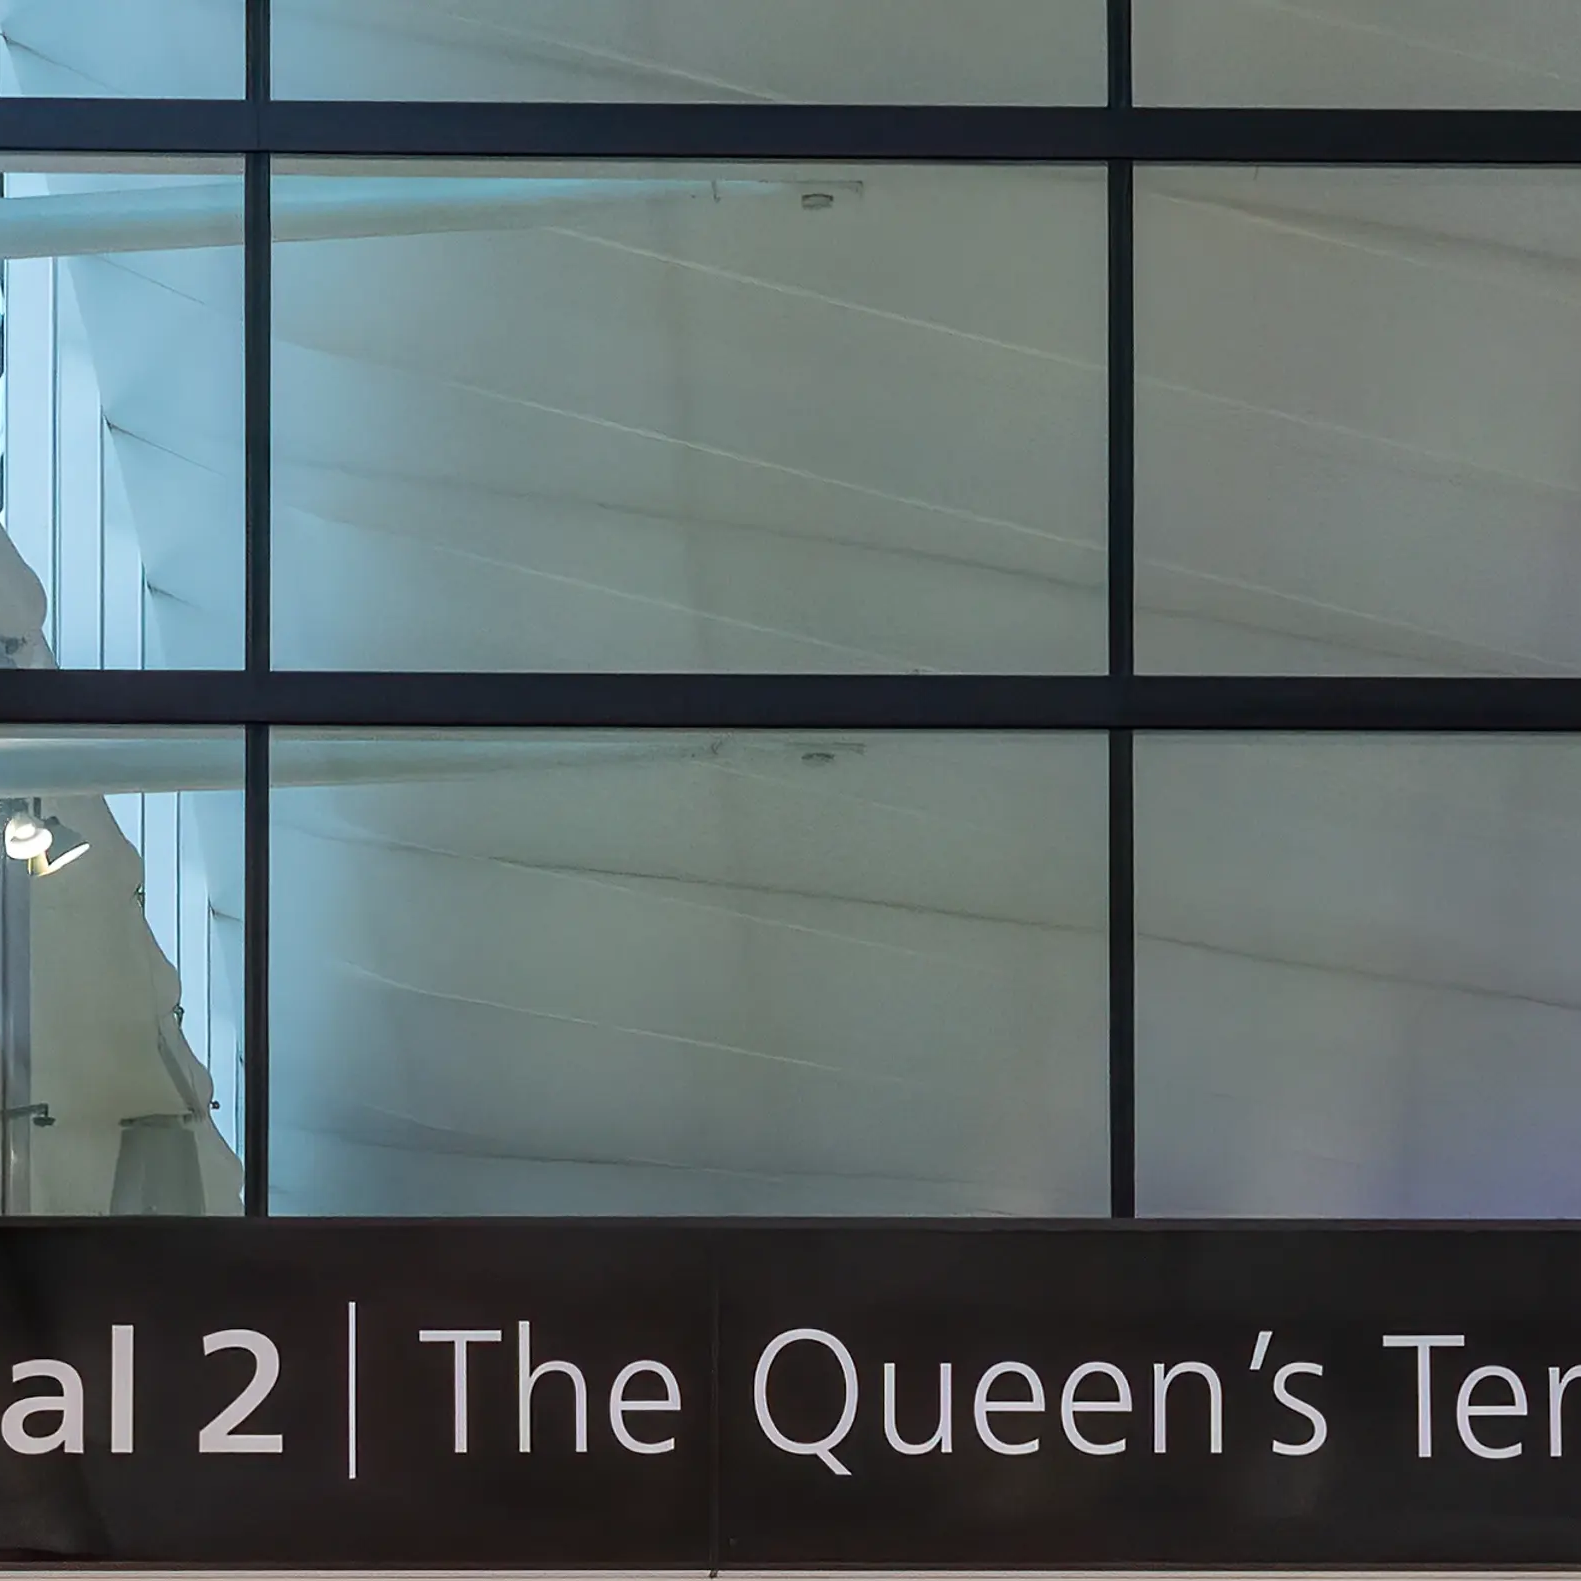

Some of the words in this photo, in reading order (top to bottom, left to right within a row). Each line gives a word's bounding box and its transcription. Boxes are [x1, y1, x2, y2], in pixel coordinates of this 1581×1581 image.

[198, 1328, 283, 1454] 2
[418, 1320, 682, 1454] The
[753, 1328, 1328, 1476] Queen's
